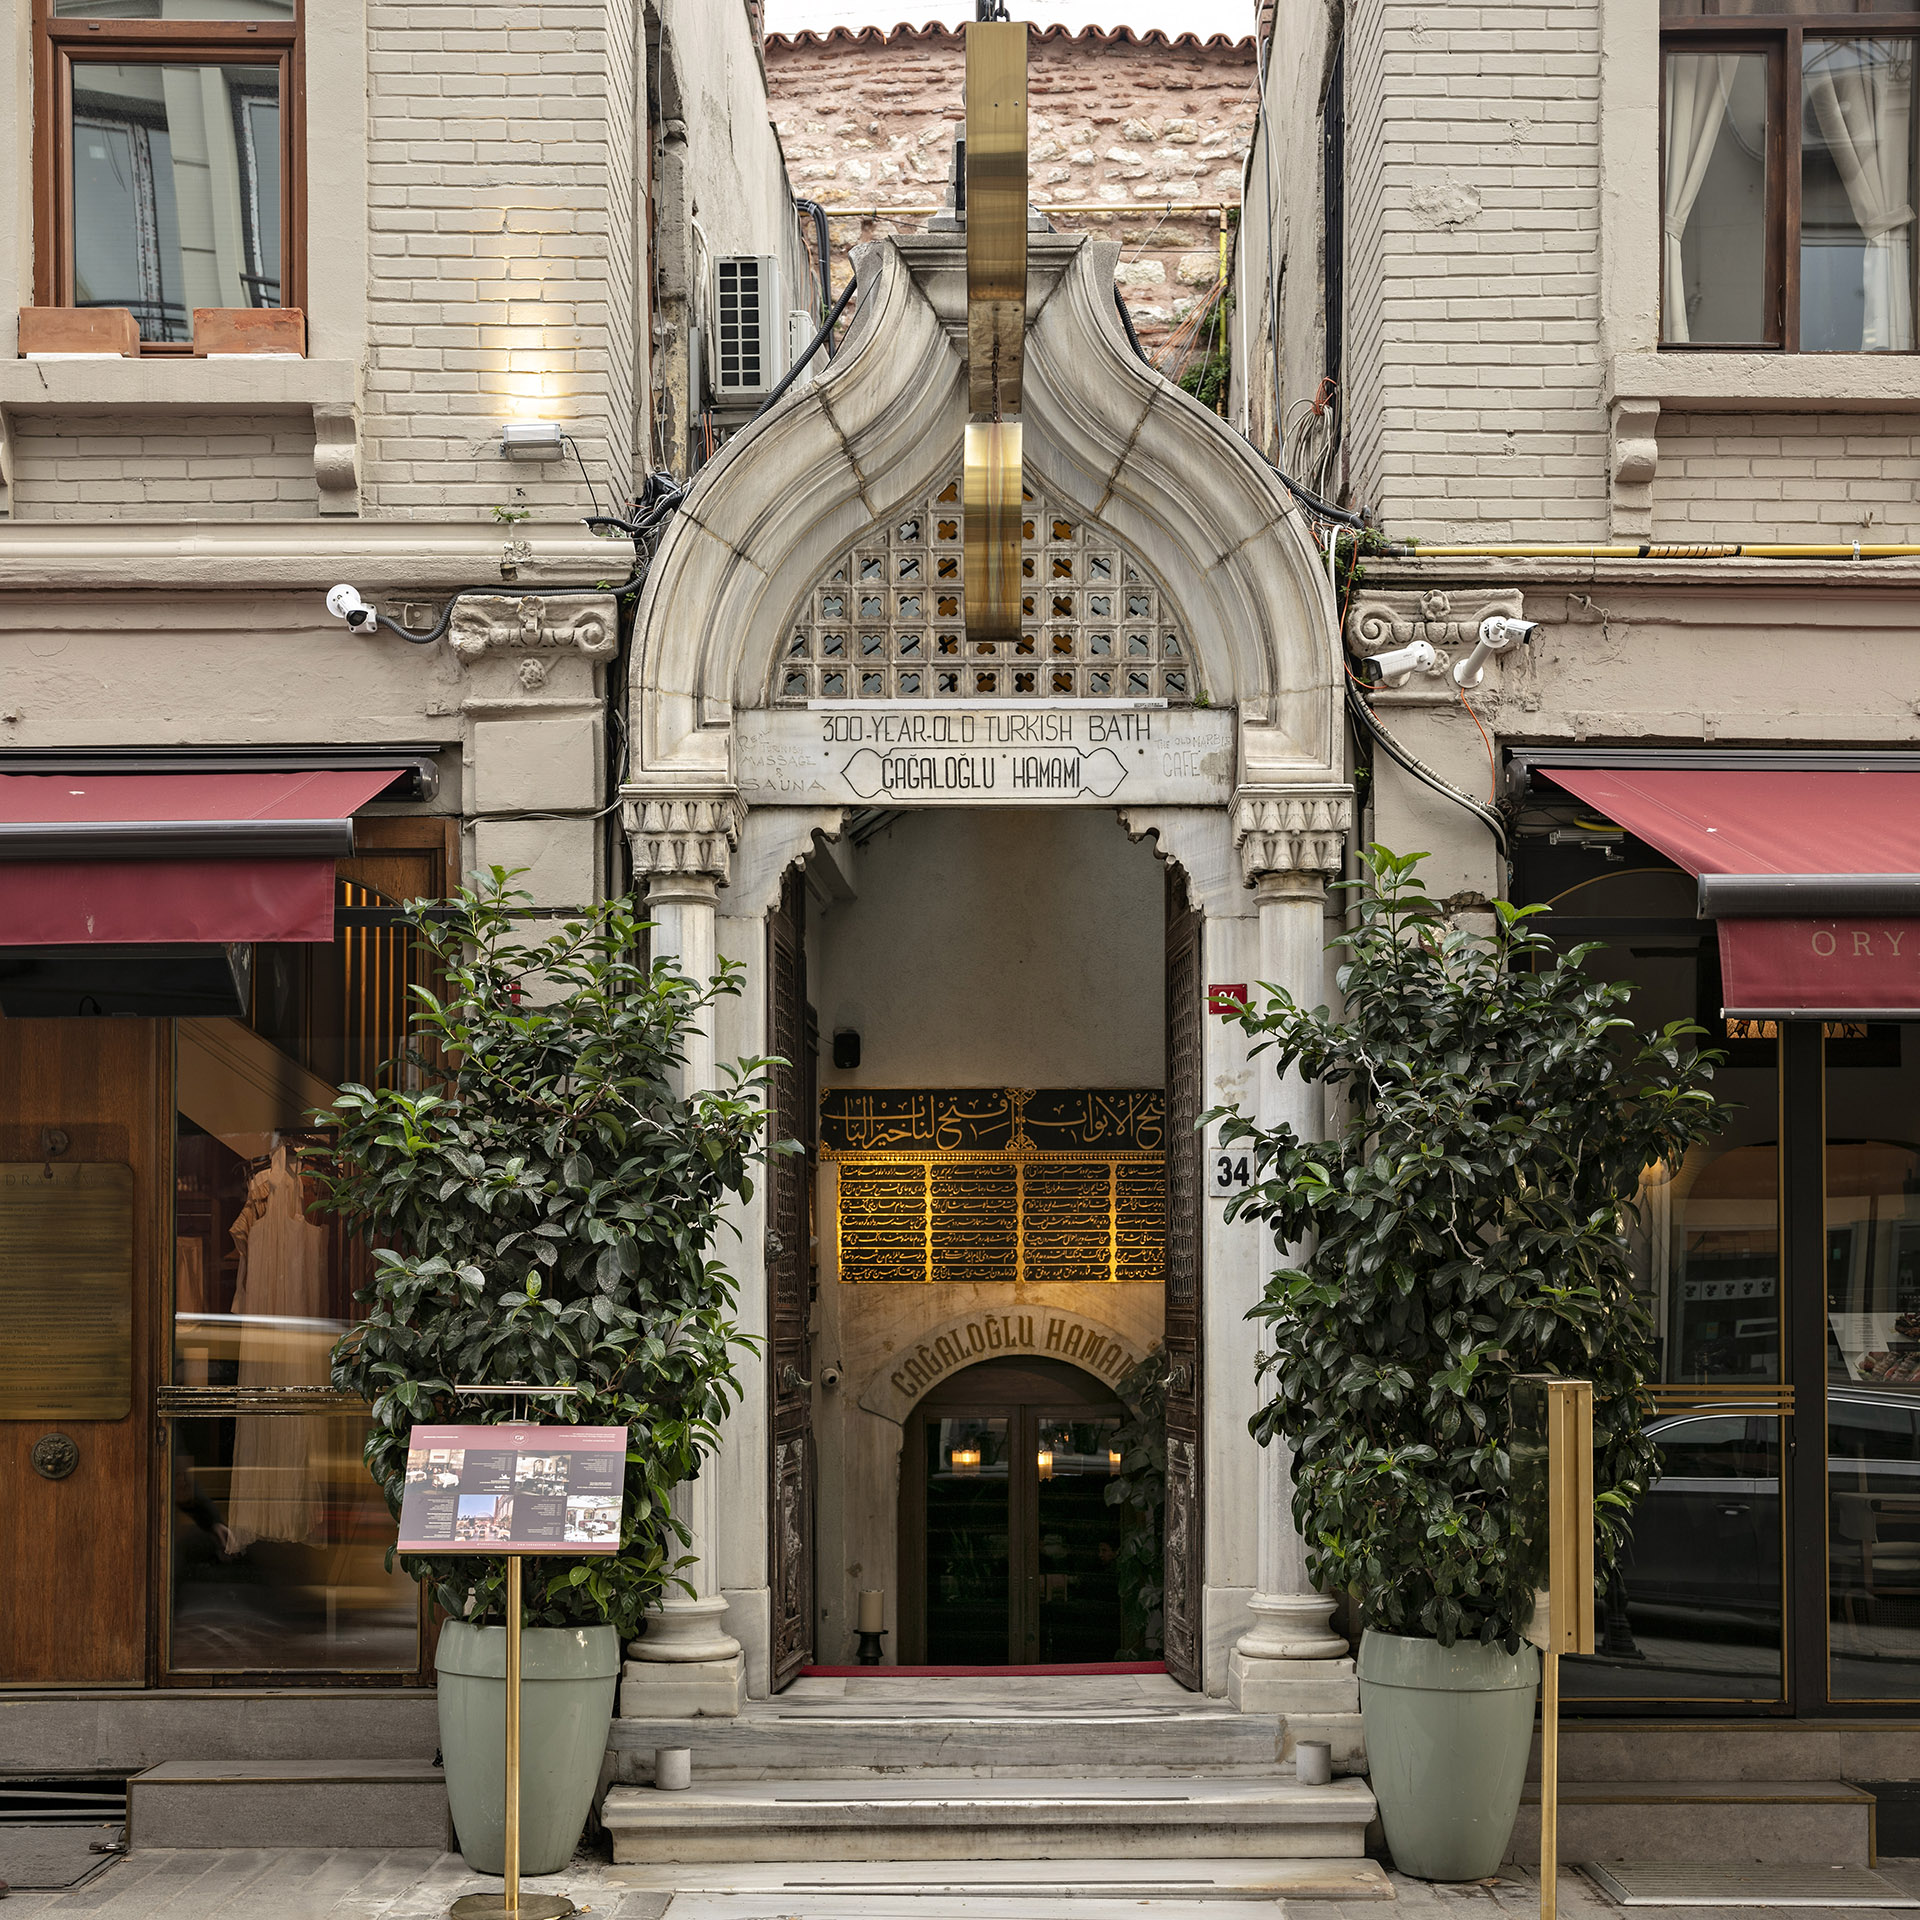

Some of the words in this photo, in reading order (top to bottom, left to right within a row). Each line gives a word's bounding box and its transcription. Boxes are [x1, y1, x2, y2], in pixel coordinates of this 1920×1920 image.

[984, 714, 1072, 743] TURKISH
[1089, 713, 1151, 742] BATH
[740, 755, 817, 767] MASSAGE
[881, 752, 995, 790] CAĞALOĞLU
[1013, 756, 1081, 789] HAMAMI
[740, 778, 827, 792] SAUNA
[1811, 930, 1920, 958] ORY
[1216, 1155, 1249, 1188] 34
[891, 1314, 1035, 1397] CAĞALOĞLU
